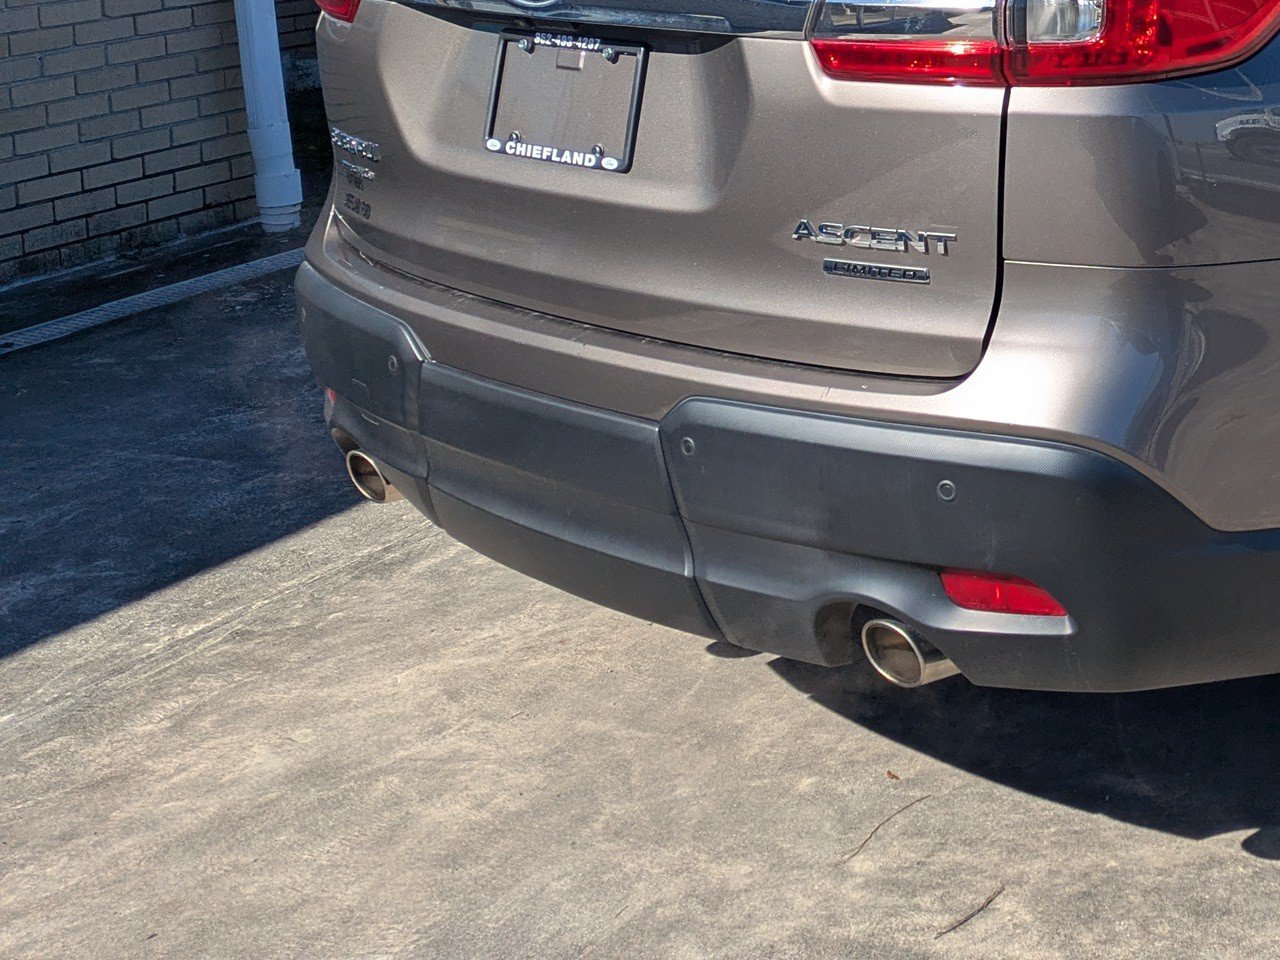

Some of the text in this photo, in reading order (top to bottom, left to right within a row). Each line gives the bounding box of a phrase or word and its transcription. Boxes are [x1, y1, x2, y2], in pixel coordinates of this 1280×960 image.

[505, 141, 596, 167] CHIEFLAND
[791, 219, 958, 256] ASCENT
[833, 262, 917, 280] LIMITED
